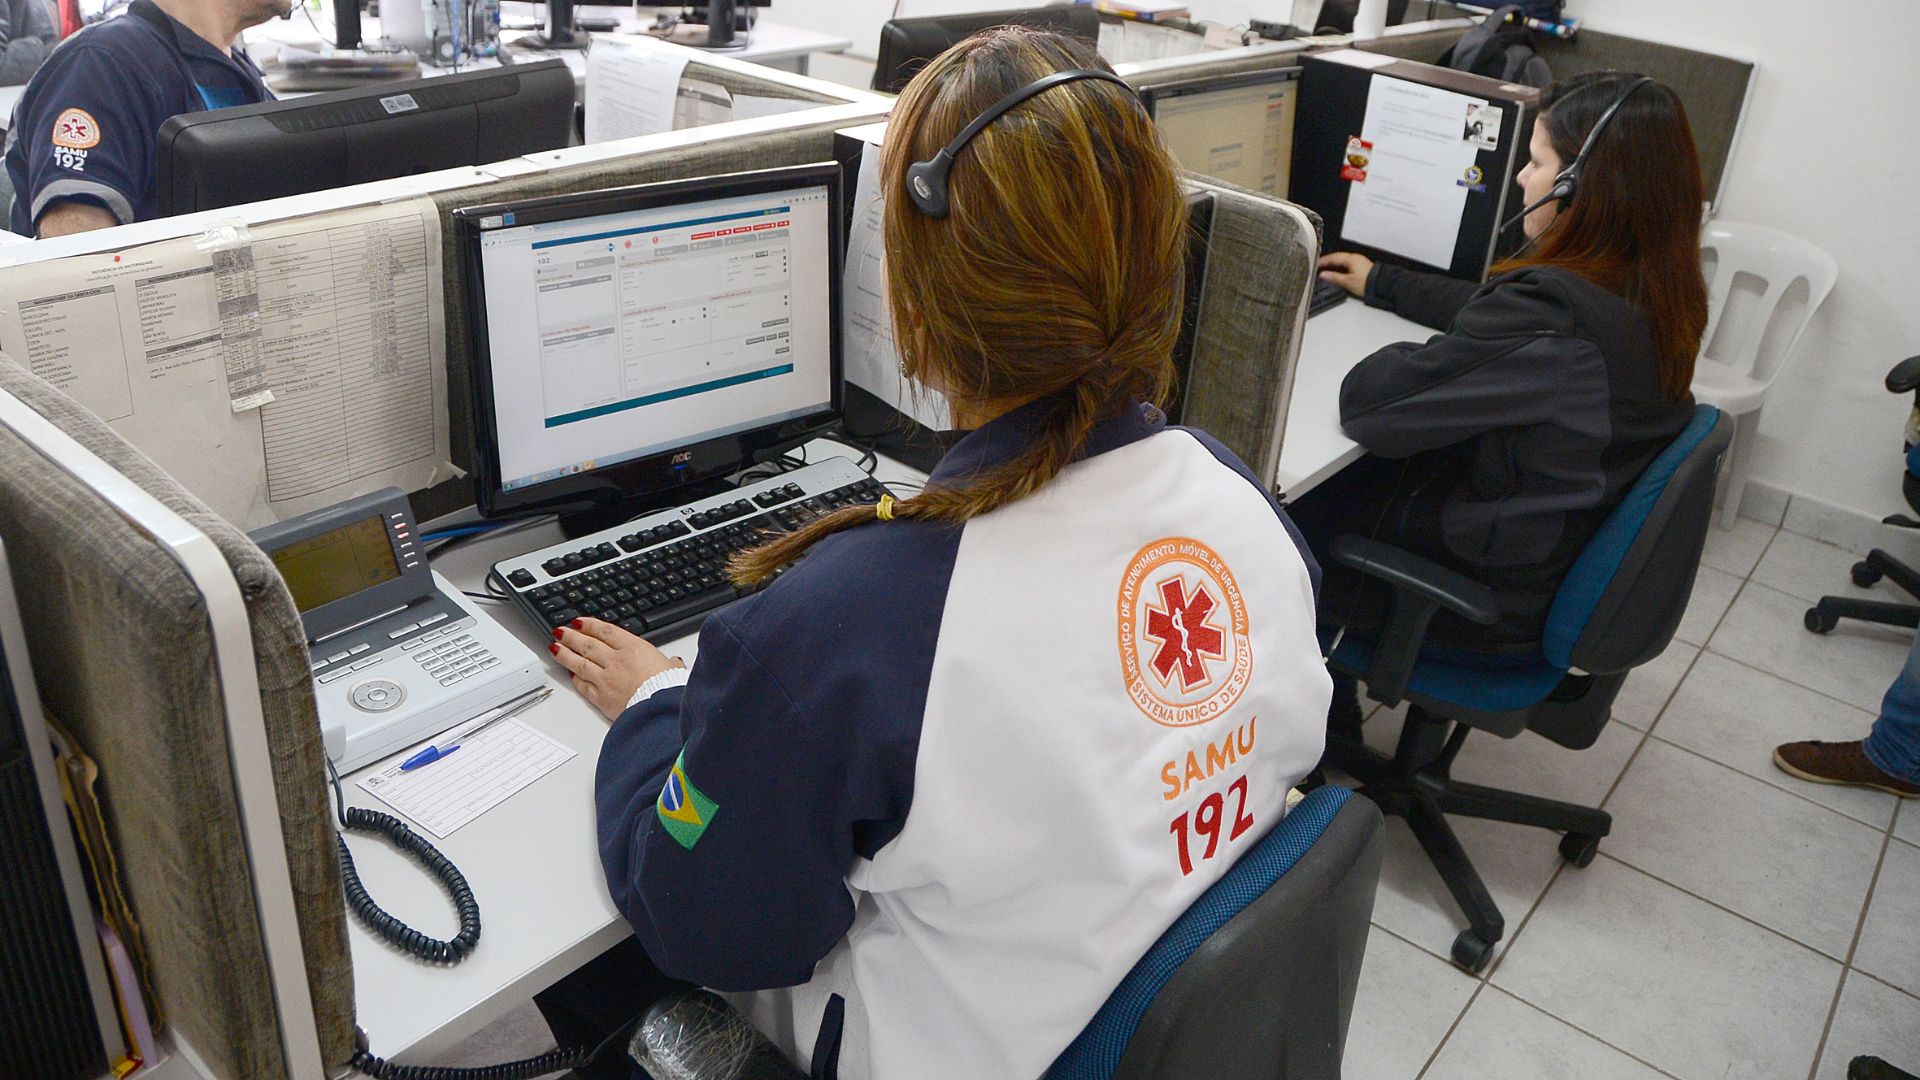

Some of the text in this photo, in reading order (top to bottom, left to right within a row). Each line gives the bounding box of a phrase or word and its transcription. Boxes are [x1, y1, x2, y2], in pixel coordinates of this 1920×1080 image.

[54, 153, 85, 171] 192
[55, 146, 88, 158] SAMU
[671, 451, 692, 464] AOC
[1179, 542, 1210, 562] MÓVEL
[1122, 543, 1176, 600] ATENDIMENTO
[1209, 559, 1223, 574] DE
[1121, 600, 1130, 618] DE
[1121, 622, 1138, 680] SERVIÇO
[1132, 681, 1174, 722] SISTEMA
[1220, 684, 1238, 704] DE
[1161, 715, 1258, 801] SAMU
[1170, 774, 1255, 877] 192
